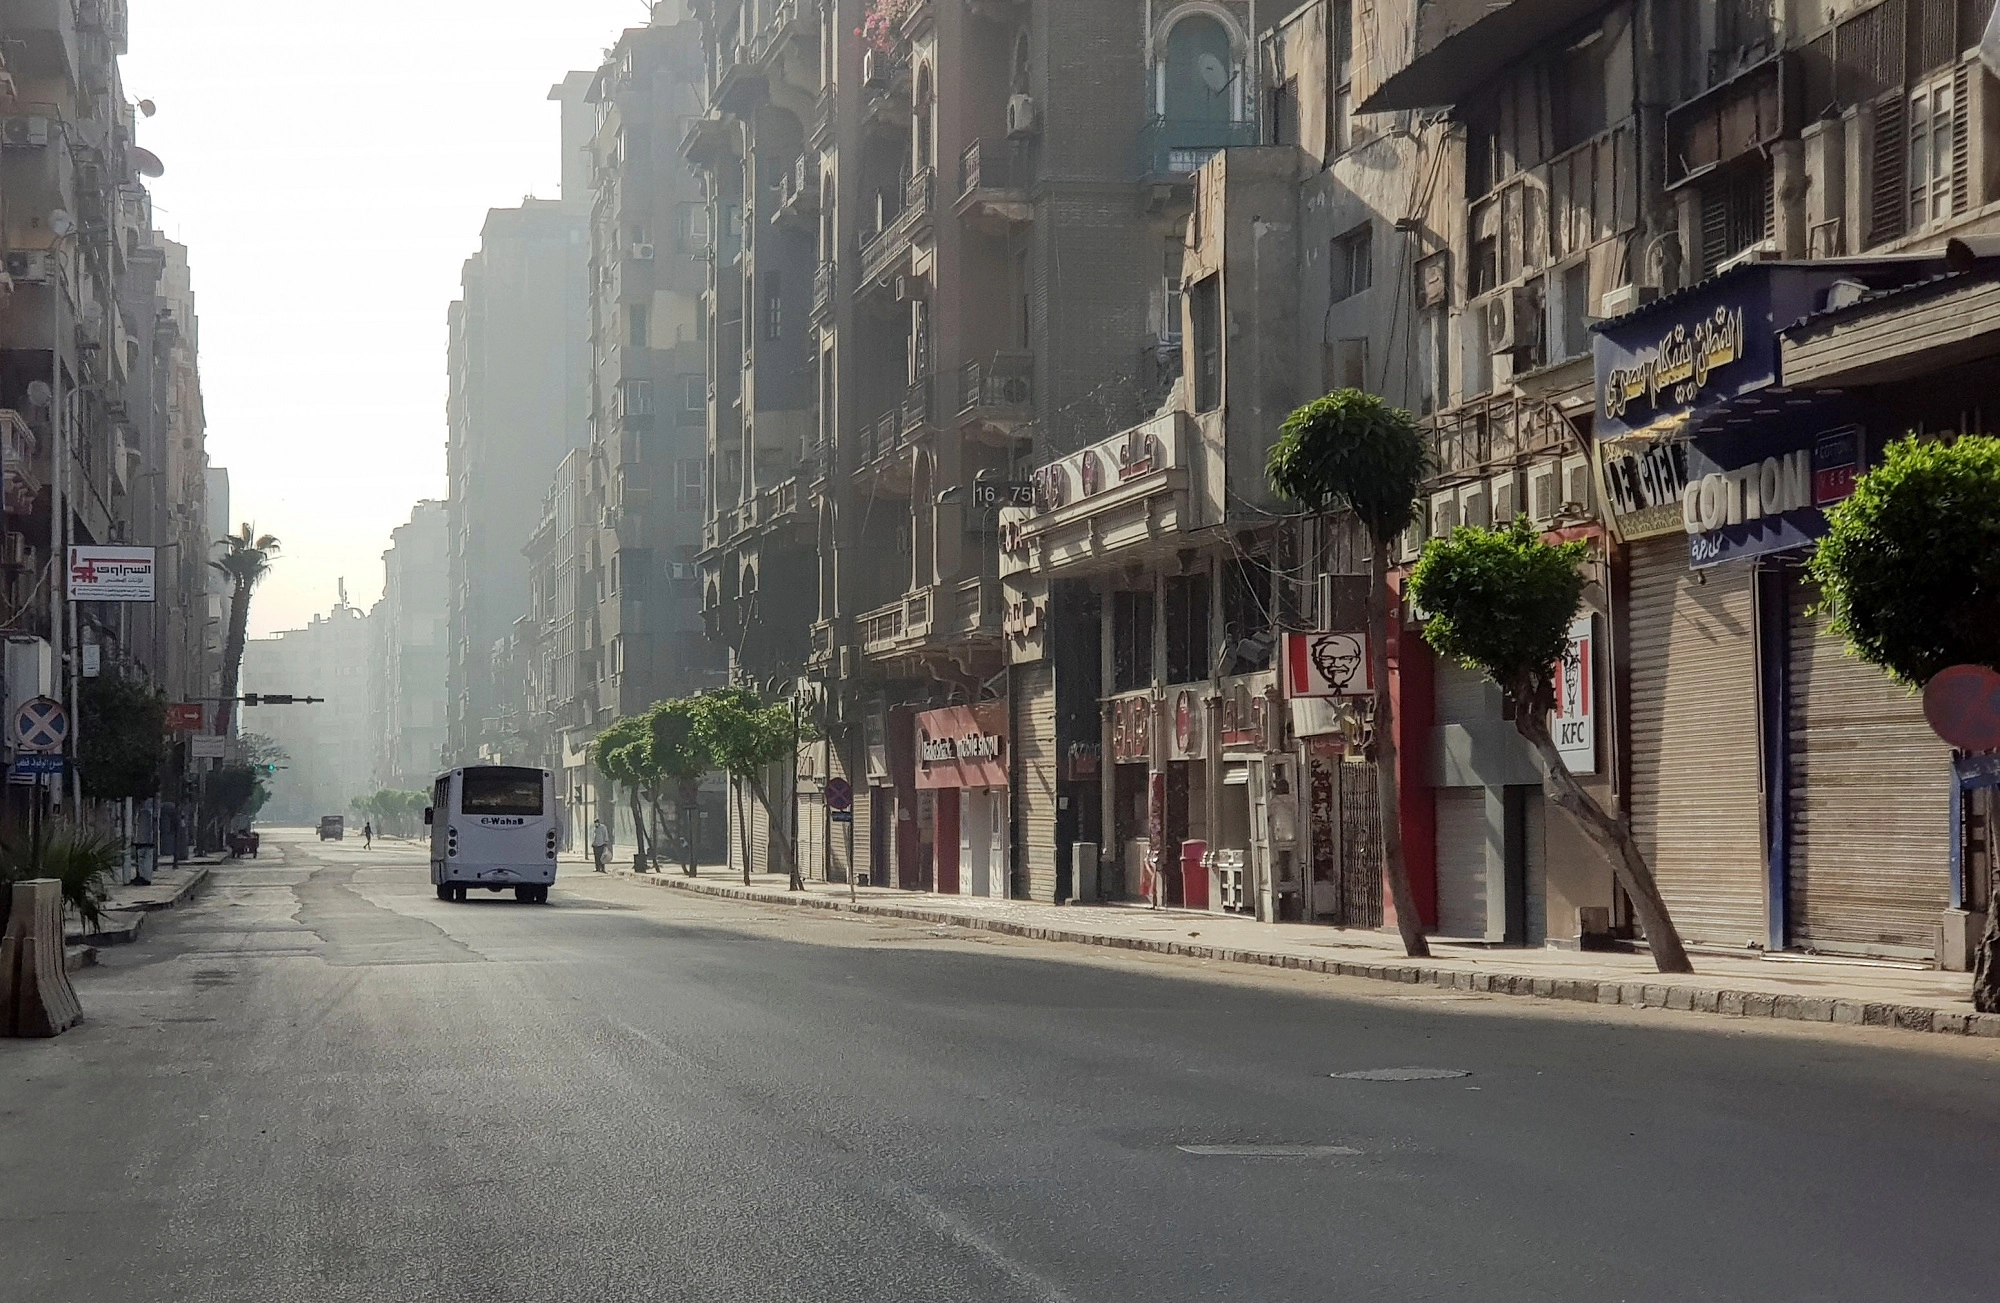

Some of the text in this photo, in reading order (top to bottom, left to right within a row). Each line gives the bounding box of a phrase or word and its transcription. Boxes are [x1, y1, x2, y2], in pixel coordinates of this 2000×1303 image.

[1695, 304, 1743, 387] القطن
[976, 486, 1031, 502] 16 75
[1604, 445, 1685, 516] LE CIEL
[1561, 721, 1585, 745] KFC
